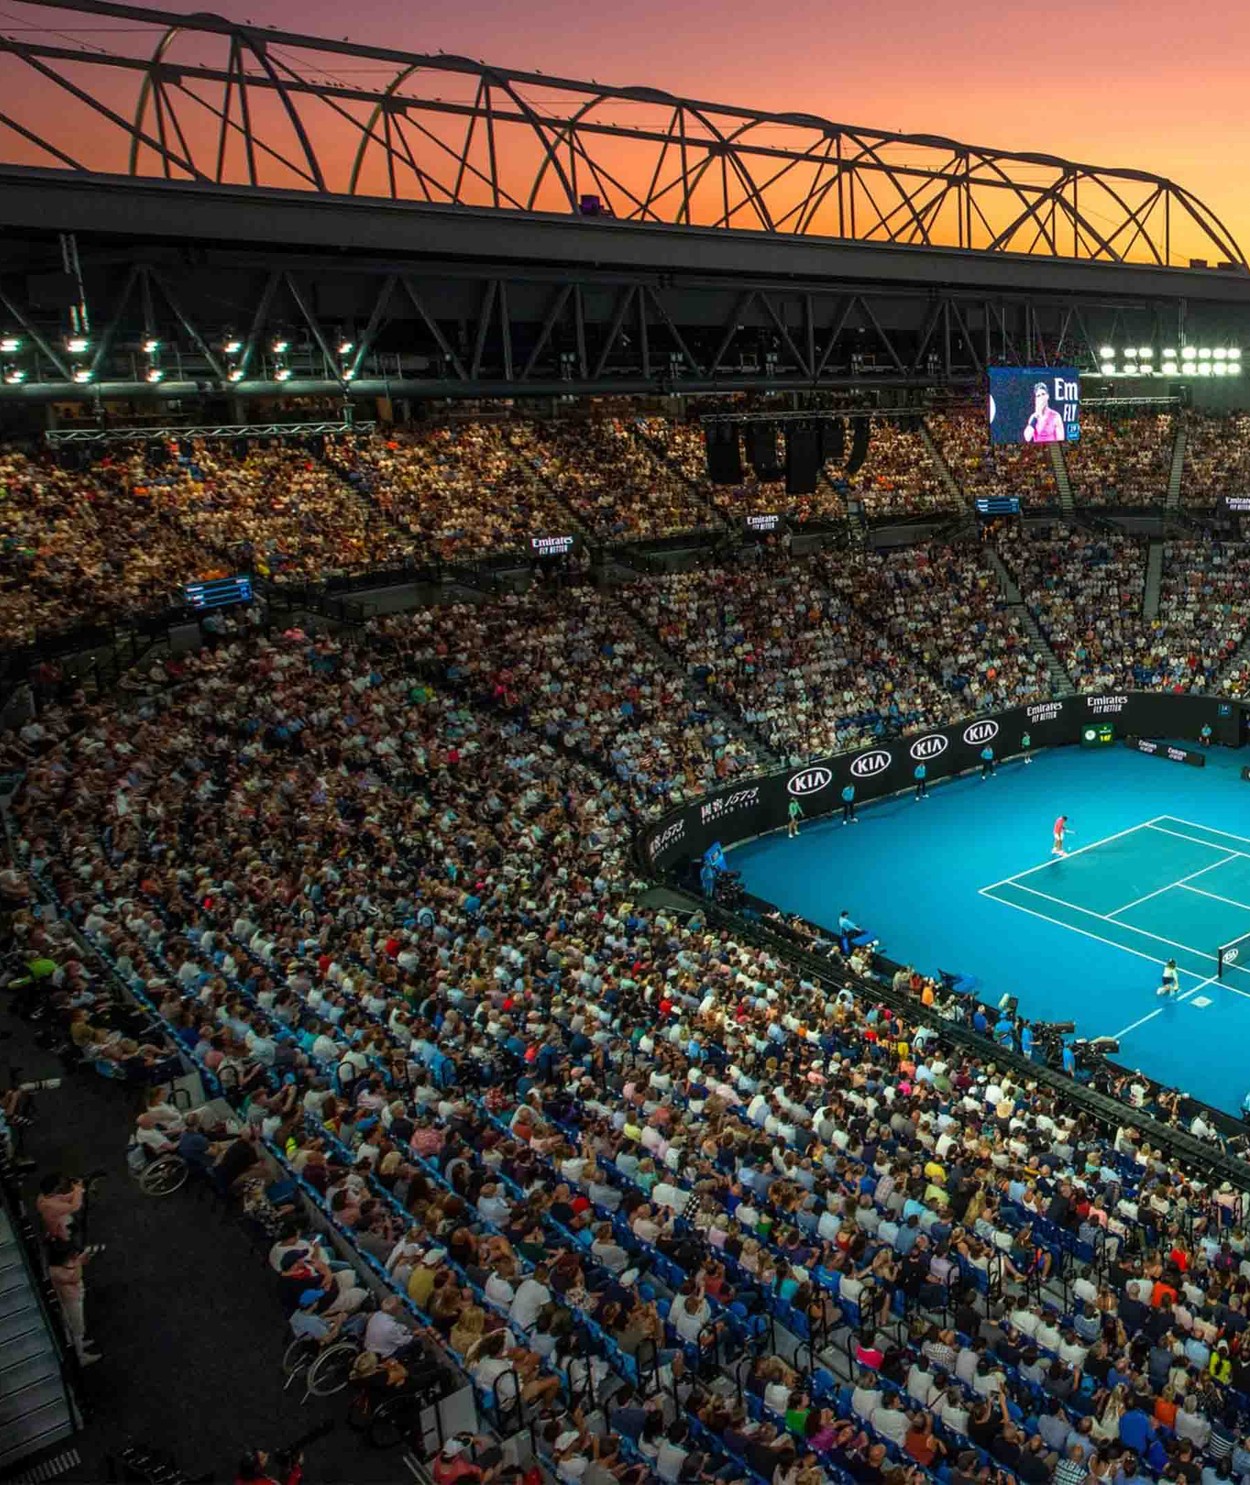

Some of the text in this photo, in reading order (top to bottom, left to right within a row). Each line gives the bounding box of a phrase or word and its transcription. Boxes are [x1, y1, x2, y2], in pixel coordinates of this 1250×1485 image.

[532, 536, 573, 548] Emirates
[1026, 701, 1063, 717] Emirates
[1087, 695, 1128, 707] Emirates
[969, 724, 993, 741] KIA
[917, 738, 942, 756] KIA
[858, 755, 885, 774] KIA
[795, 771, 825, 792] KIA
[724, 787, 759, 807] 1573
